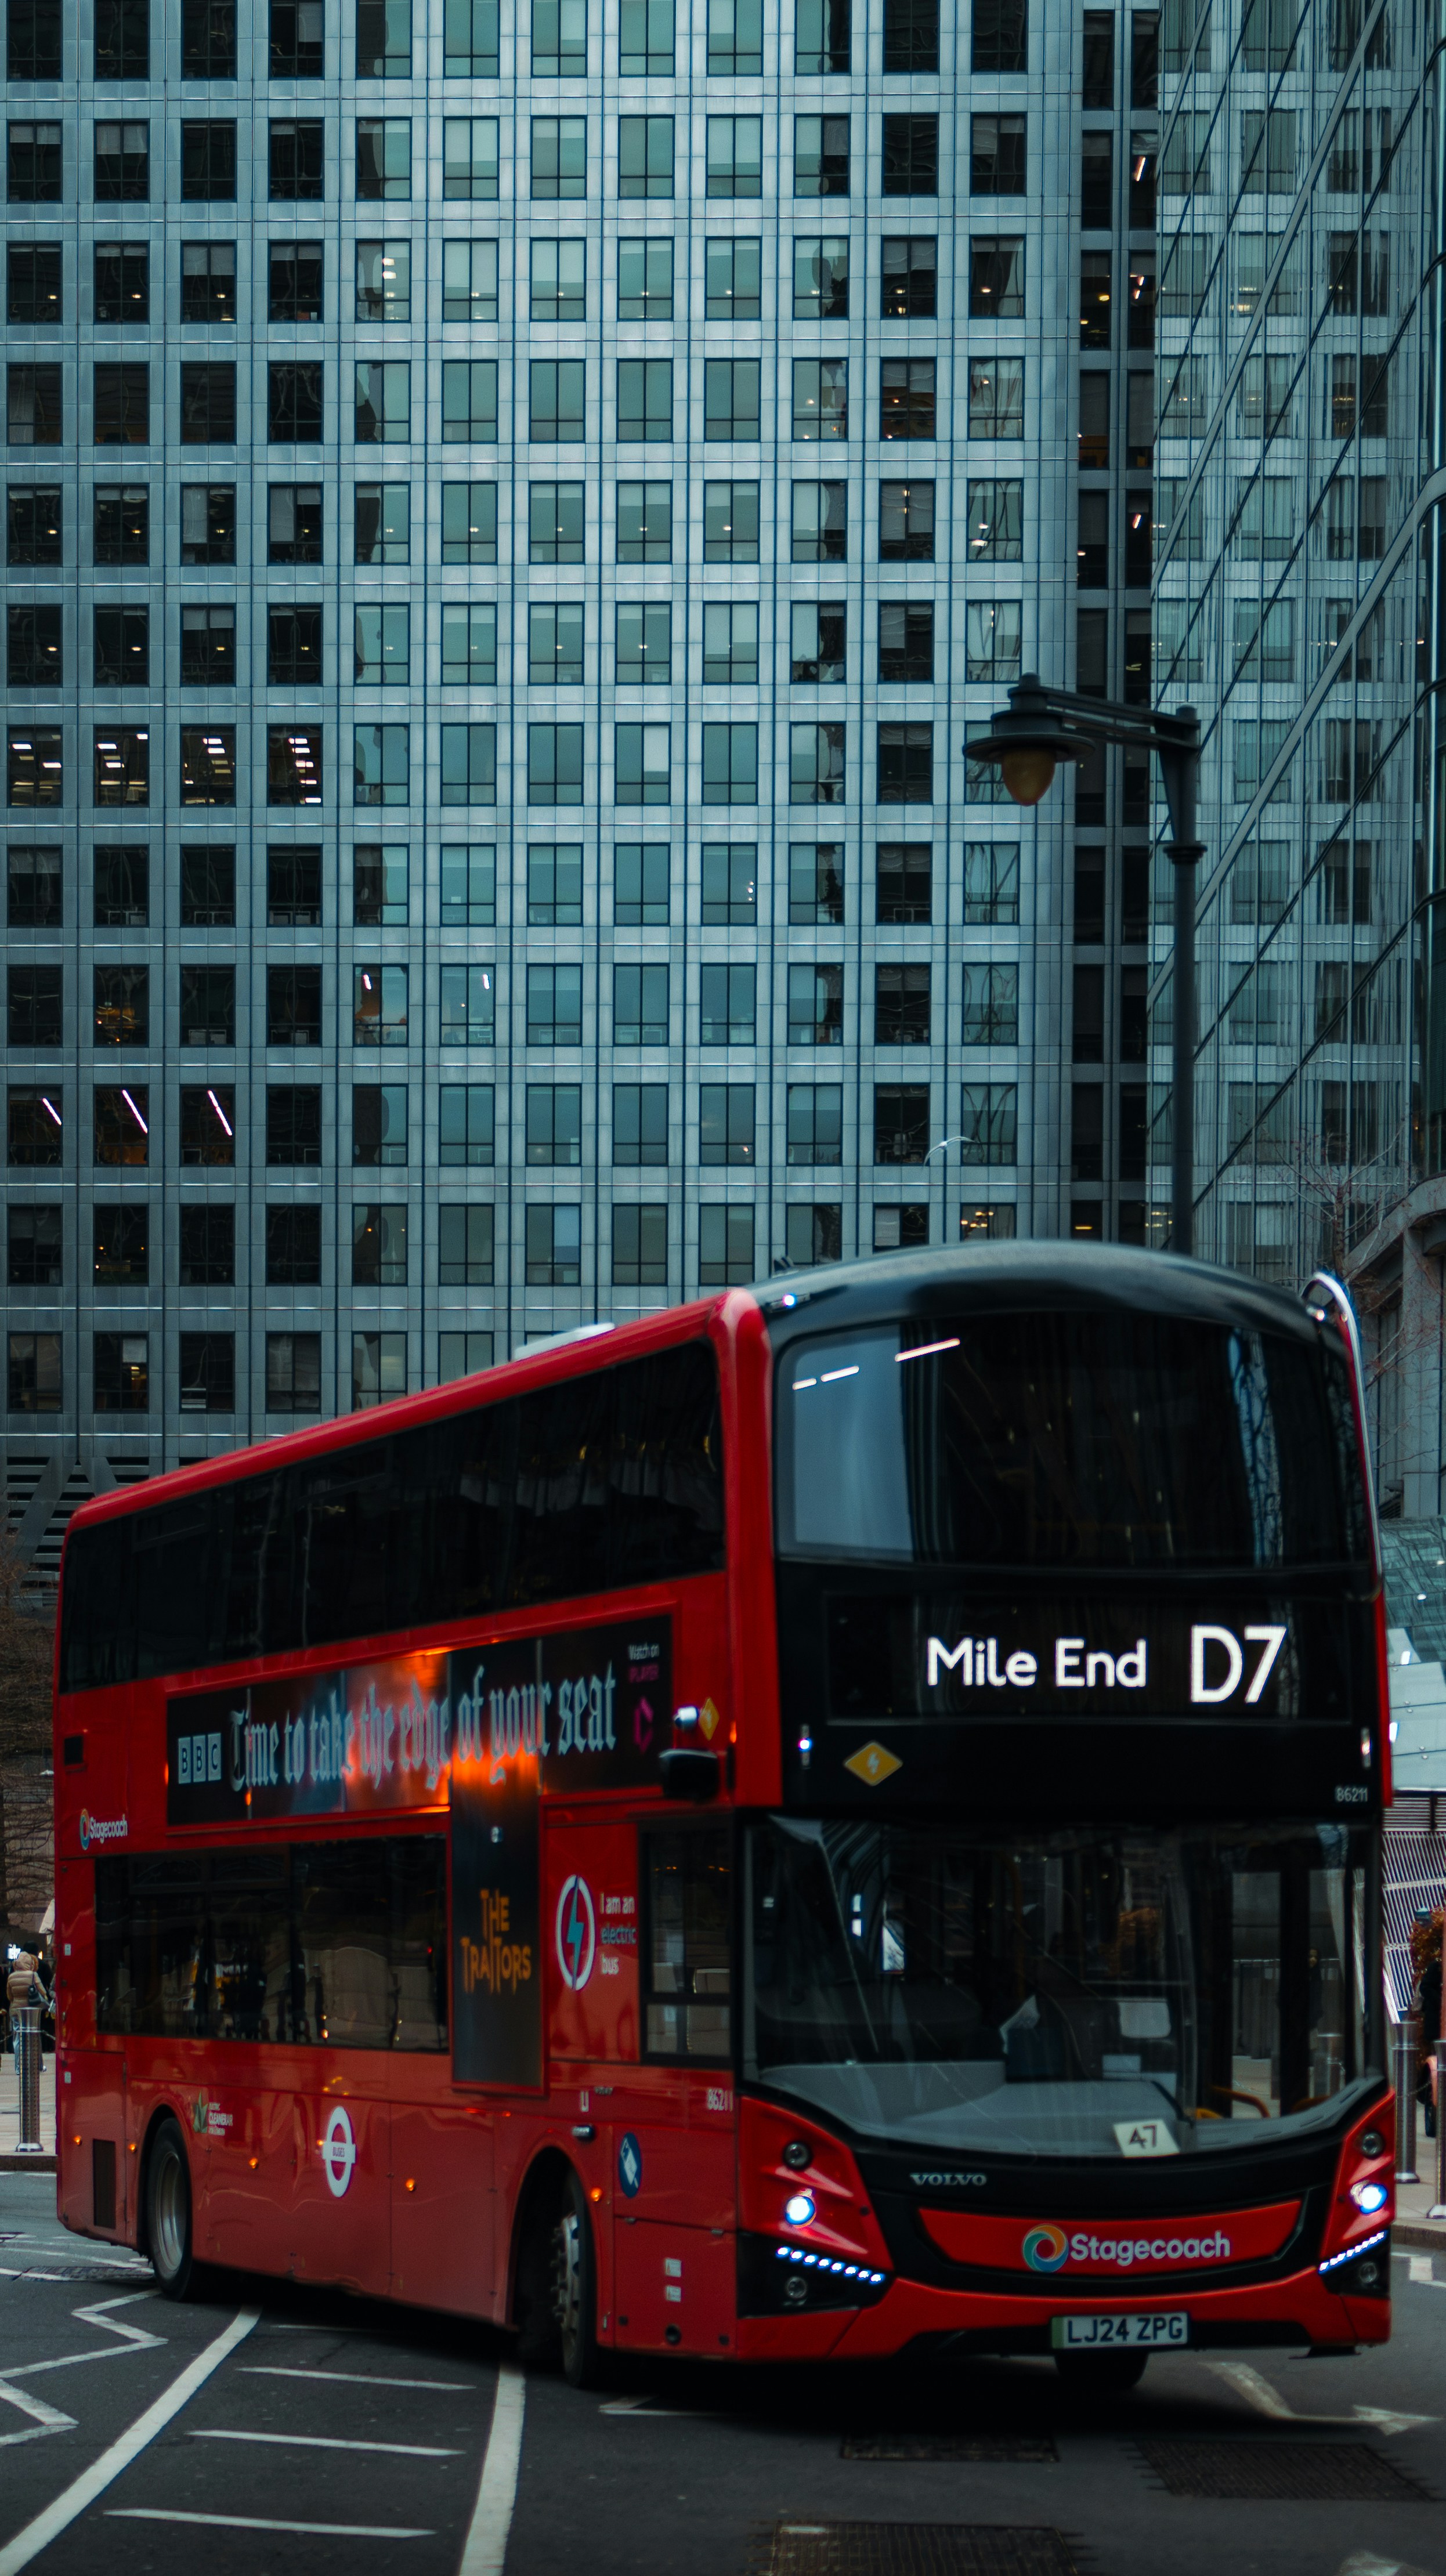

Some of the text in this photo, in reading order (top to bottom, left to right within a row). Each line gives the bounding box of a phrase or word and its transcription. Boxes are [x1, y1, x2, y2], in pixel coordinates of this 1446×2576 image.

[628, 1643, 660, 1660] Watch on
[927, 1637, 1147, 1687] Mile End
[1191, 1625, 1286, 1703] D7
[231, 1660, 616, 1792] Time to take the edge of your seat
[178, 1732, 222, 1785] BBC
[1335, 1786, 1368, 1803] 86211
[89, 1814, 128, 1844] Stagecoach
[480, 1888, 509, 1942] THE
[600, 1893, 635, 1914] I am an
[601, 1923, 637, 1944] electric
[460, 1937, 532, 1995] TRAITORS
[601, 1953, 619, 1975] bus
[707, 2087, 733, 2111] 86211
[1128, 2125, 1157, 2148] 47
[910, 2172, 987, 2186] VOLVO
[1070, 2231, 1230, 2266] Stagecoach
[1068, 2316, 1183, 2343] LJ24 ZPG
